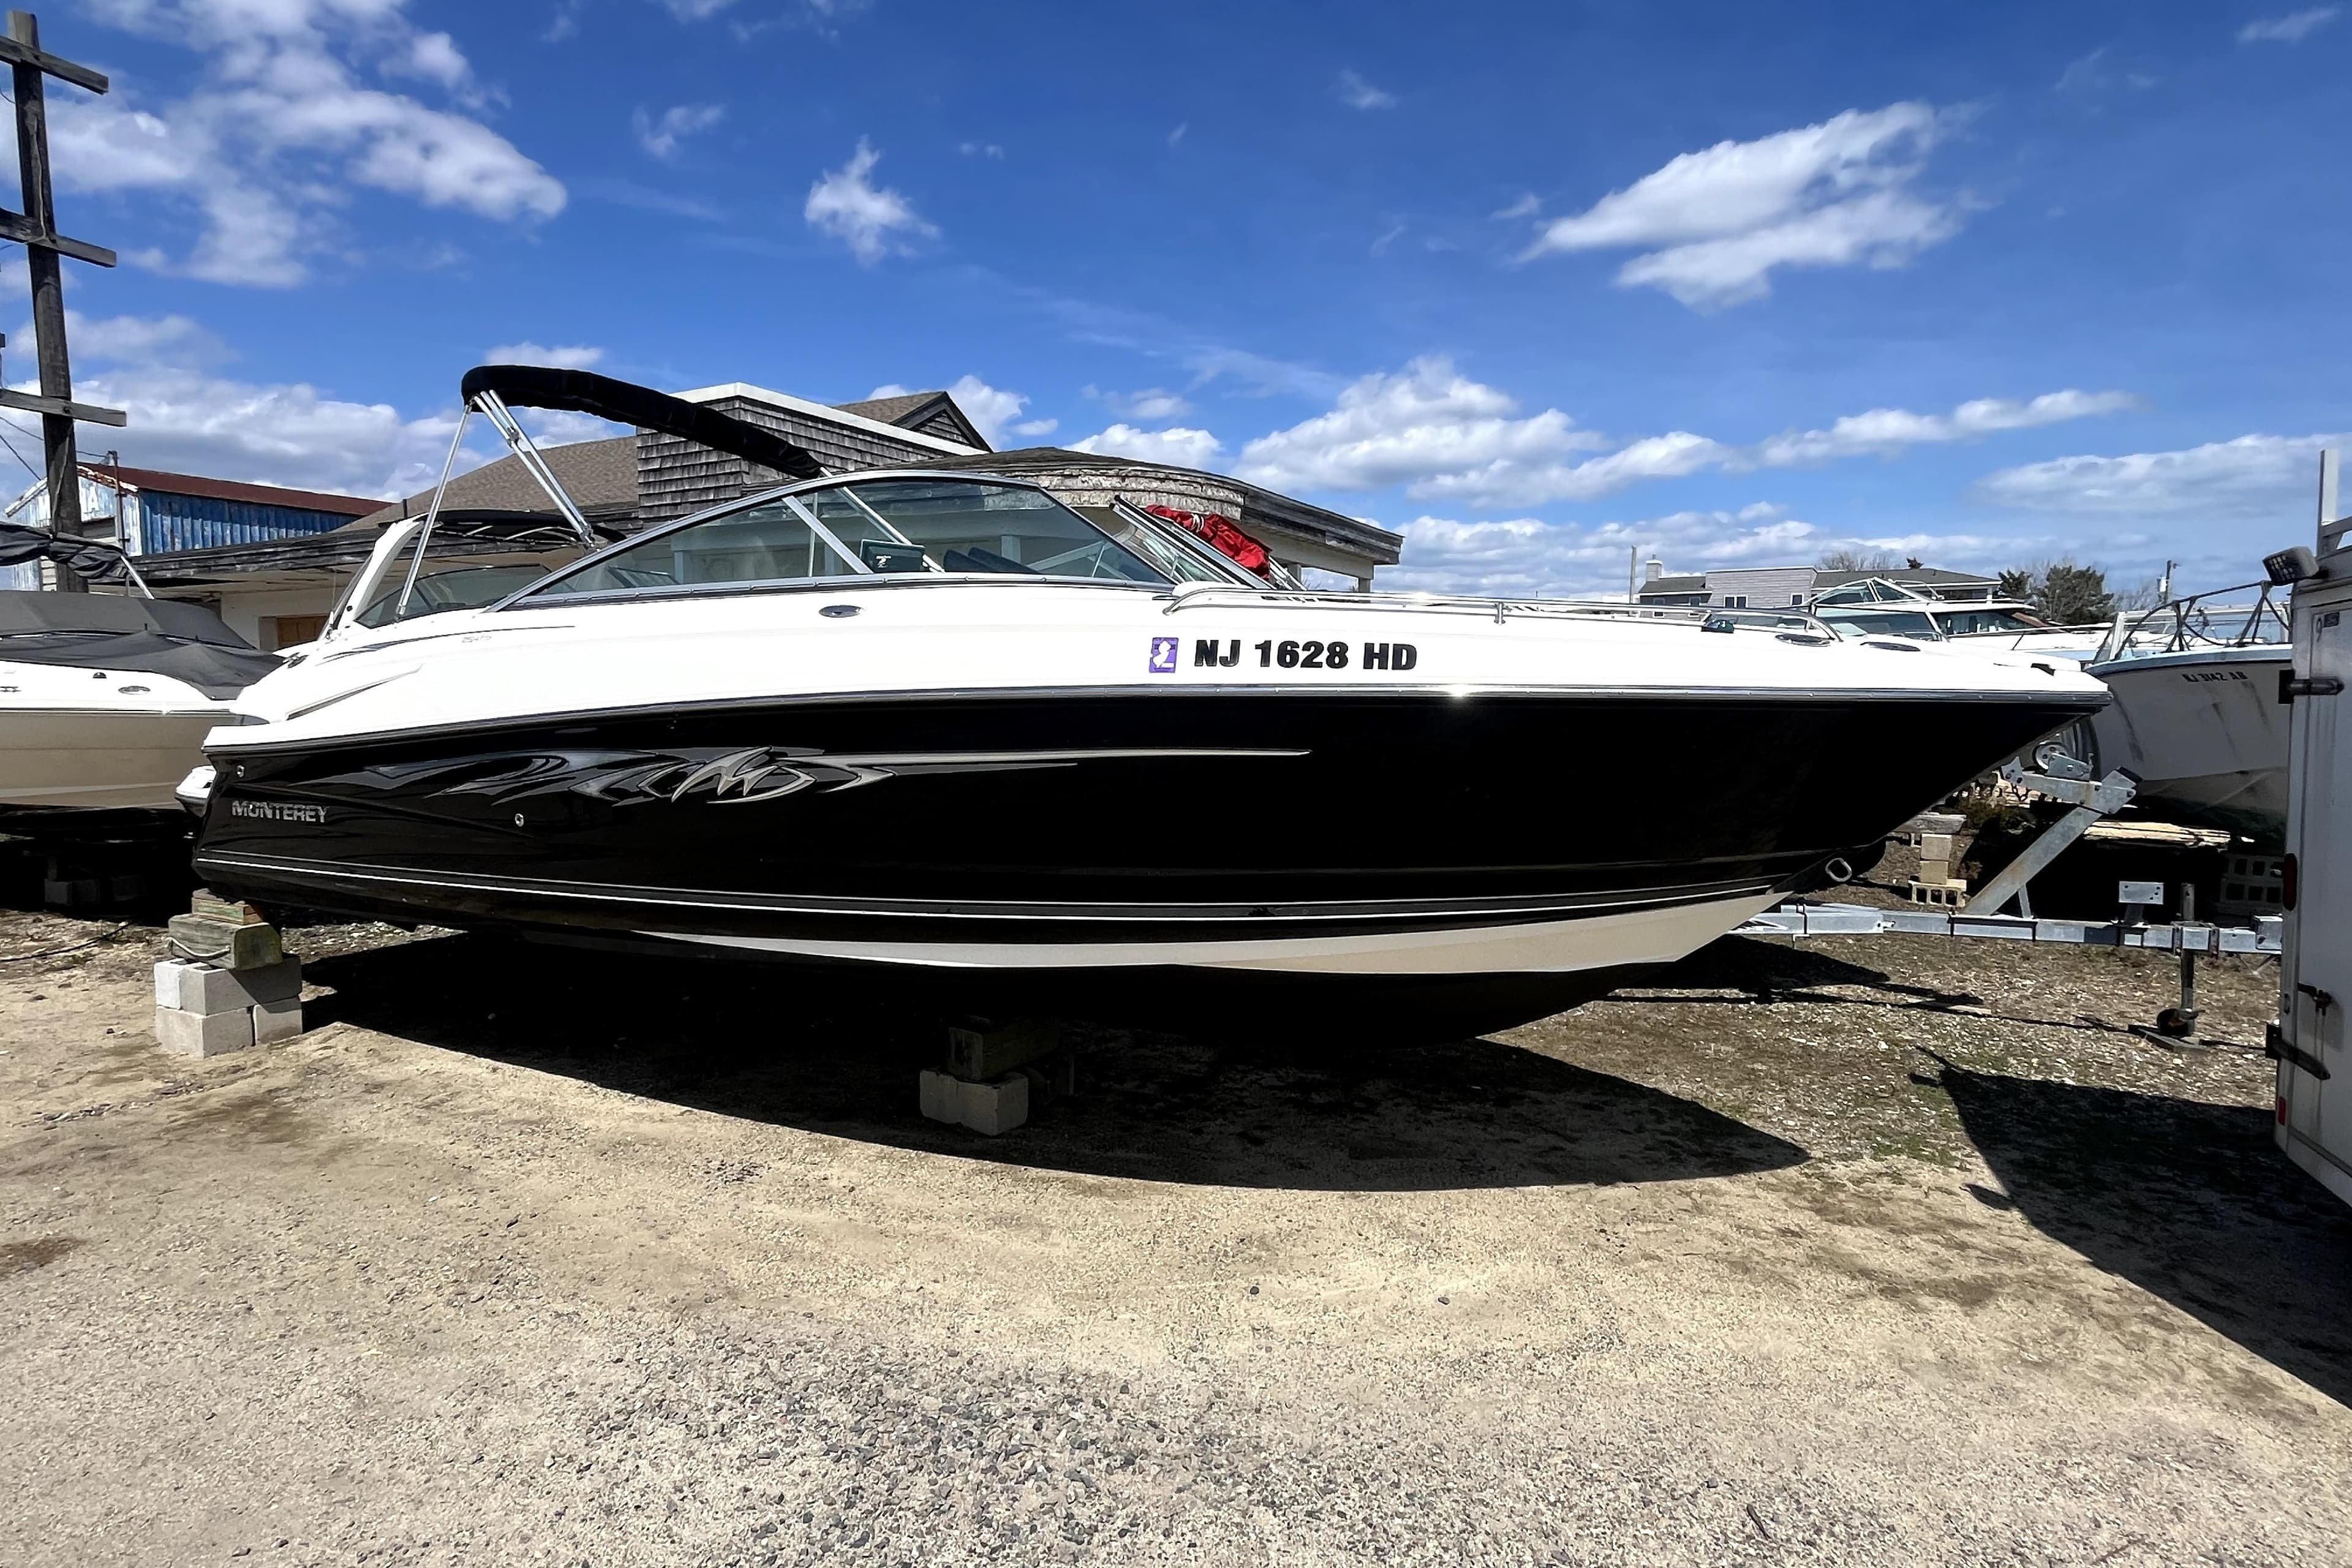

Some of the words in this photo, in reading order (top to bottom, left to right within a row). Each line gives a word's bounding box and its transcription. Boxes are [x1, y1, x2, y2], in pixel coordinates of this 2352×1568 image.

[1194, 639, 1241, 667] NJ
[1255, 640, 1349, 669] 1628
[1363, 643, 1417, 670] HD
[232, 801, 330, 823] MONTEREY
